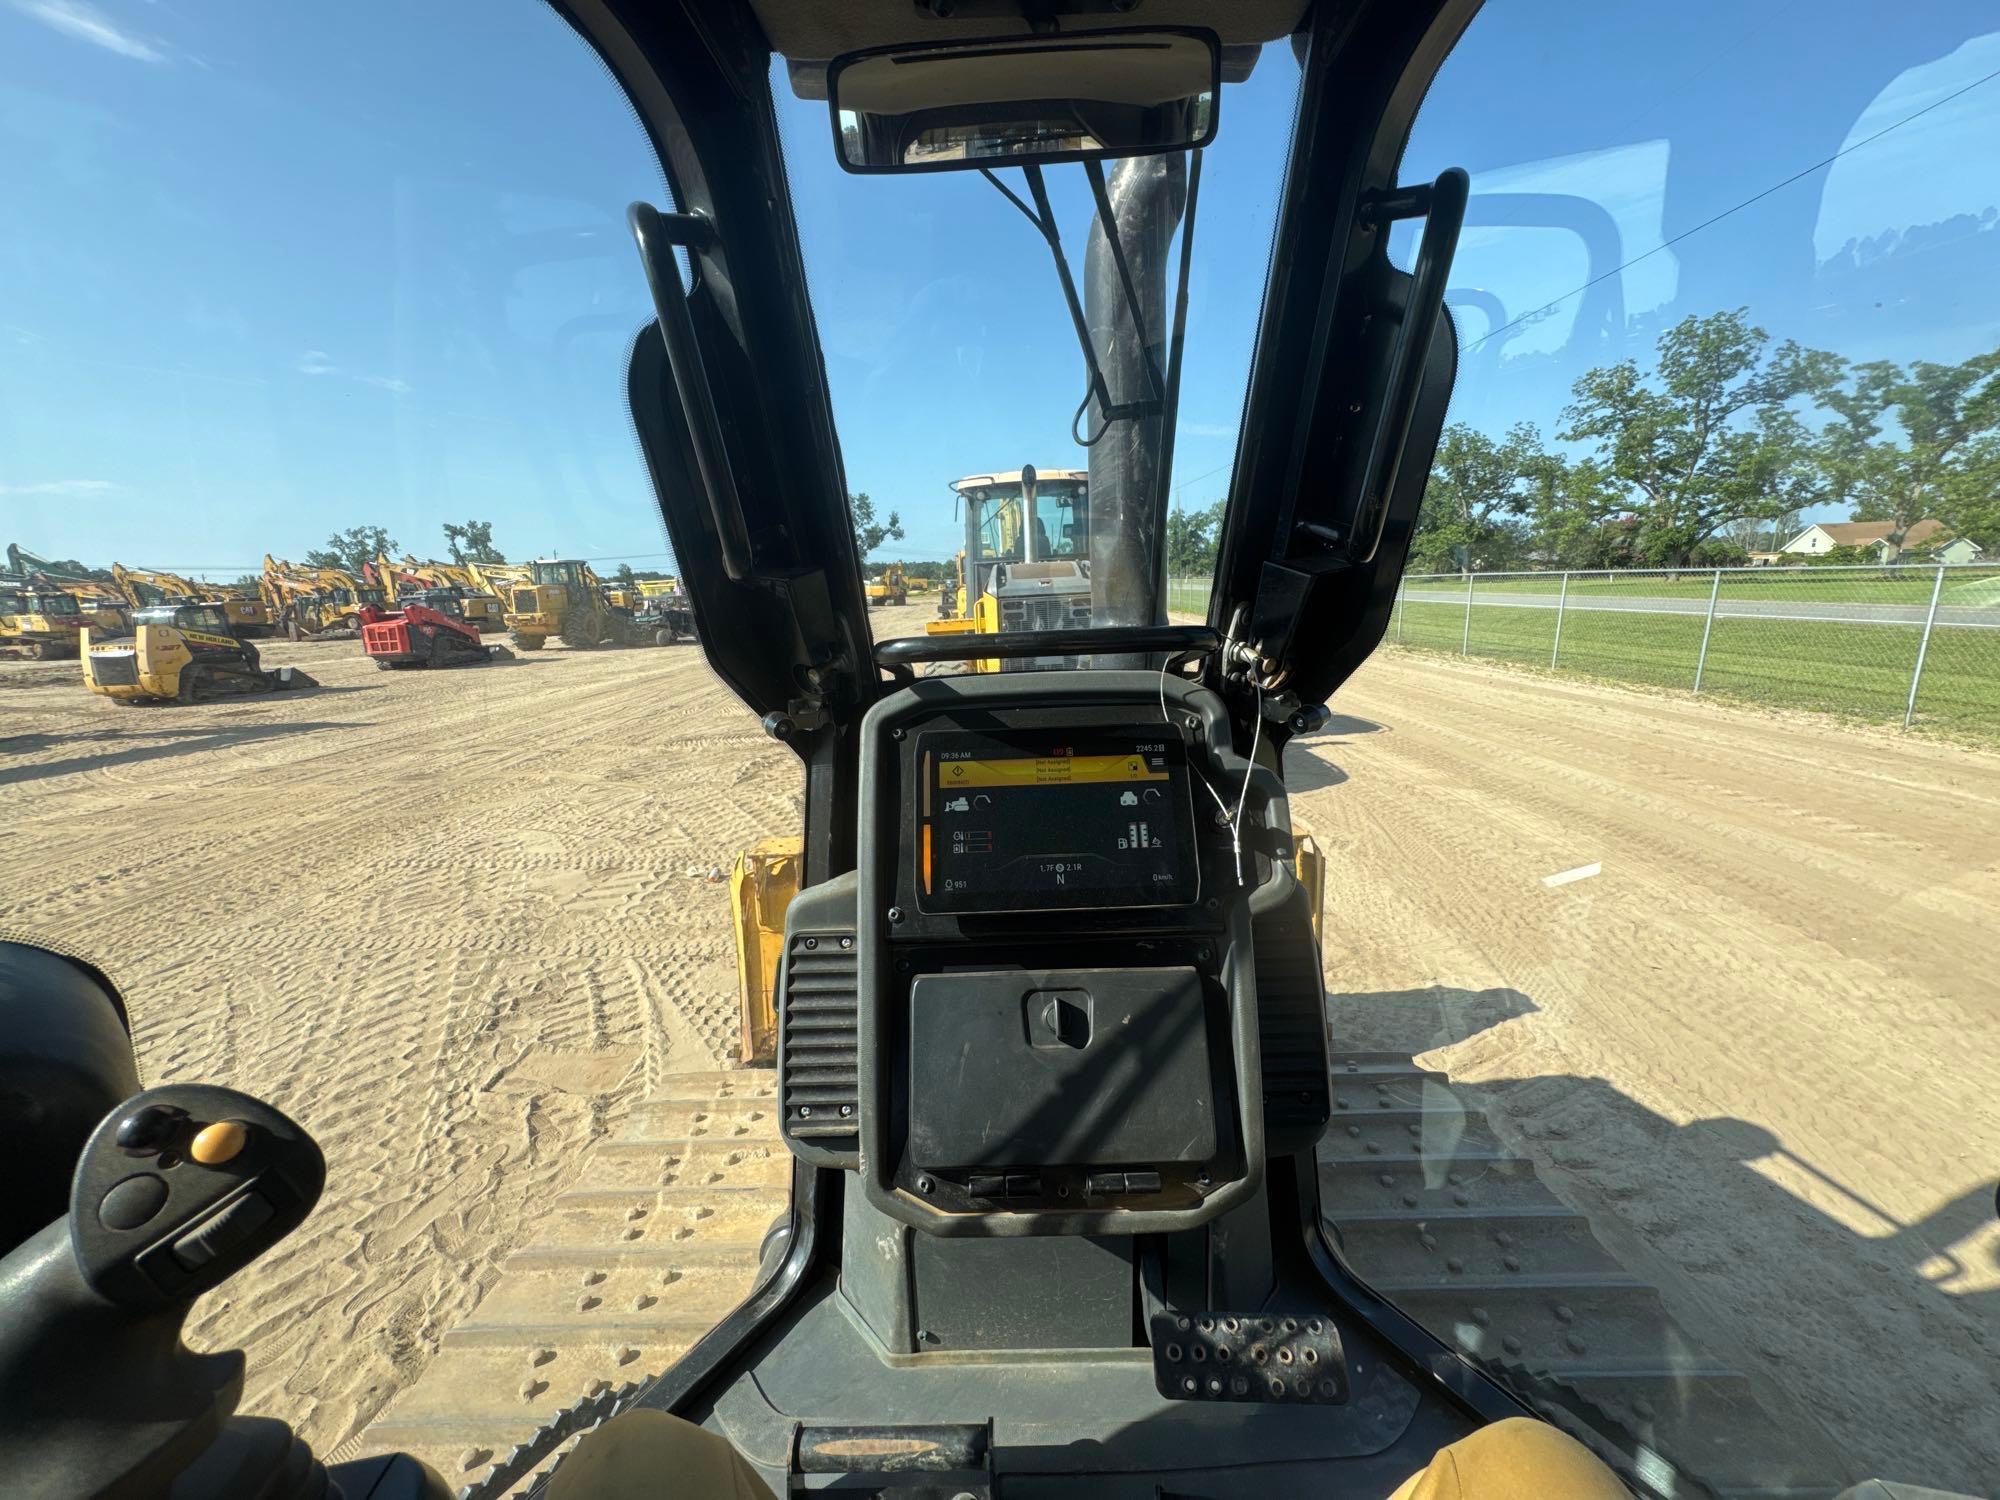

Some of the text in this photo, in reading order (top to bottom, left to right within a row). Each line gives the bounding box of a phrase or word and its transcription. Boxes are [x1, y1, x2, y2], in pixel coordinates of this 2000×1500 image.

[240, 606, 253, 615] CAT
[190, 633, 236, 646] NEW HOLLAND
[1056, 873, 1065, 885] N
